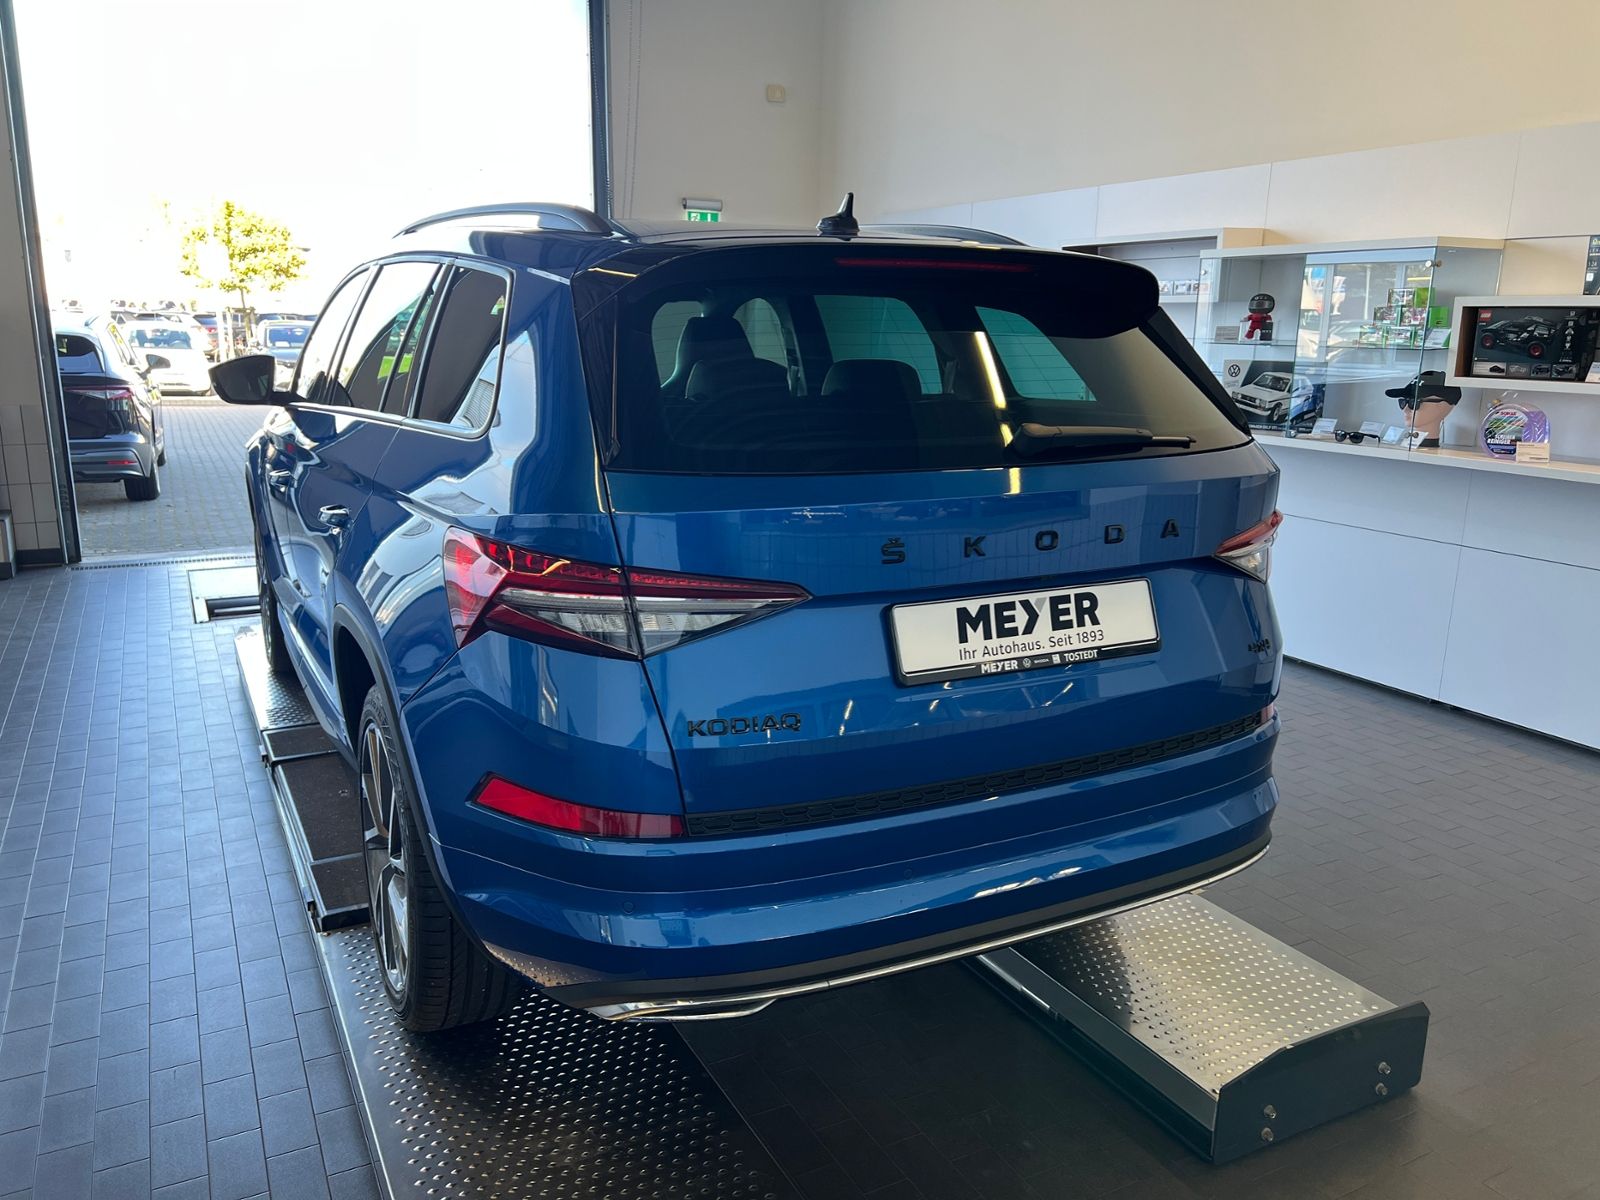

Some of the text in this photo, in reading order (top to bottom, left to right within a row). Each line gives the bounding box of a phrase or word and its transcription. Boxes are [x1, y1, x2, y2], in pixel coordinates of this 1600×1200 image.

[955, 591, 1101, 644] MEYER
[958, 629, 1105, 661] Ihr Autohaus. Seit 1893
[981, 660, 1019, 674] MEYER
[1063, 649, 1099, 662] TOSTEDT
[688, 712, 801, 738] KODIAQ
